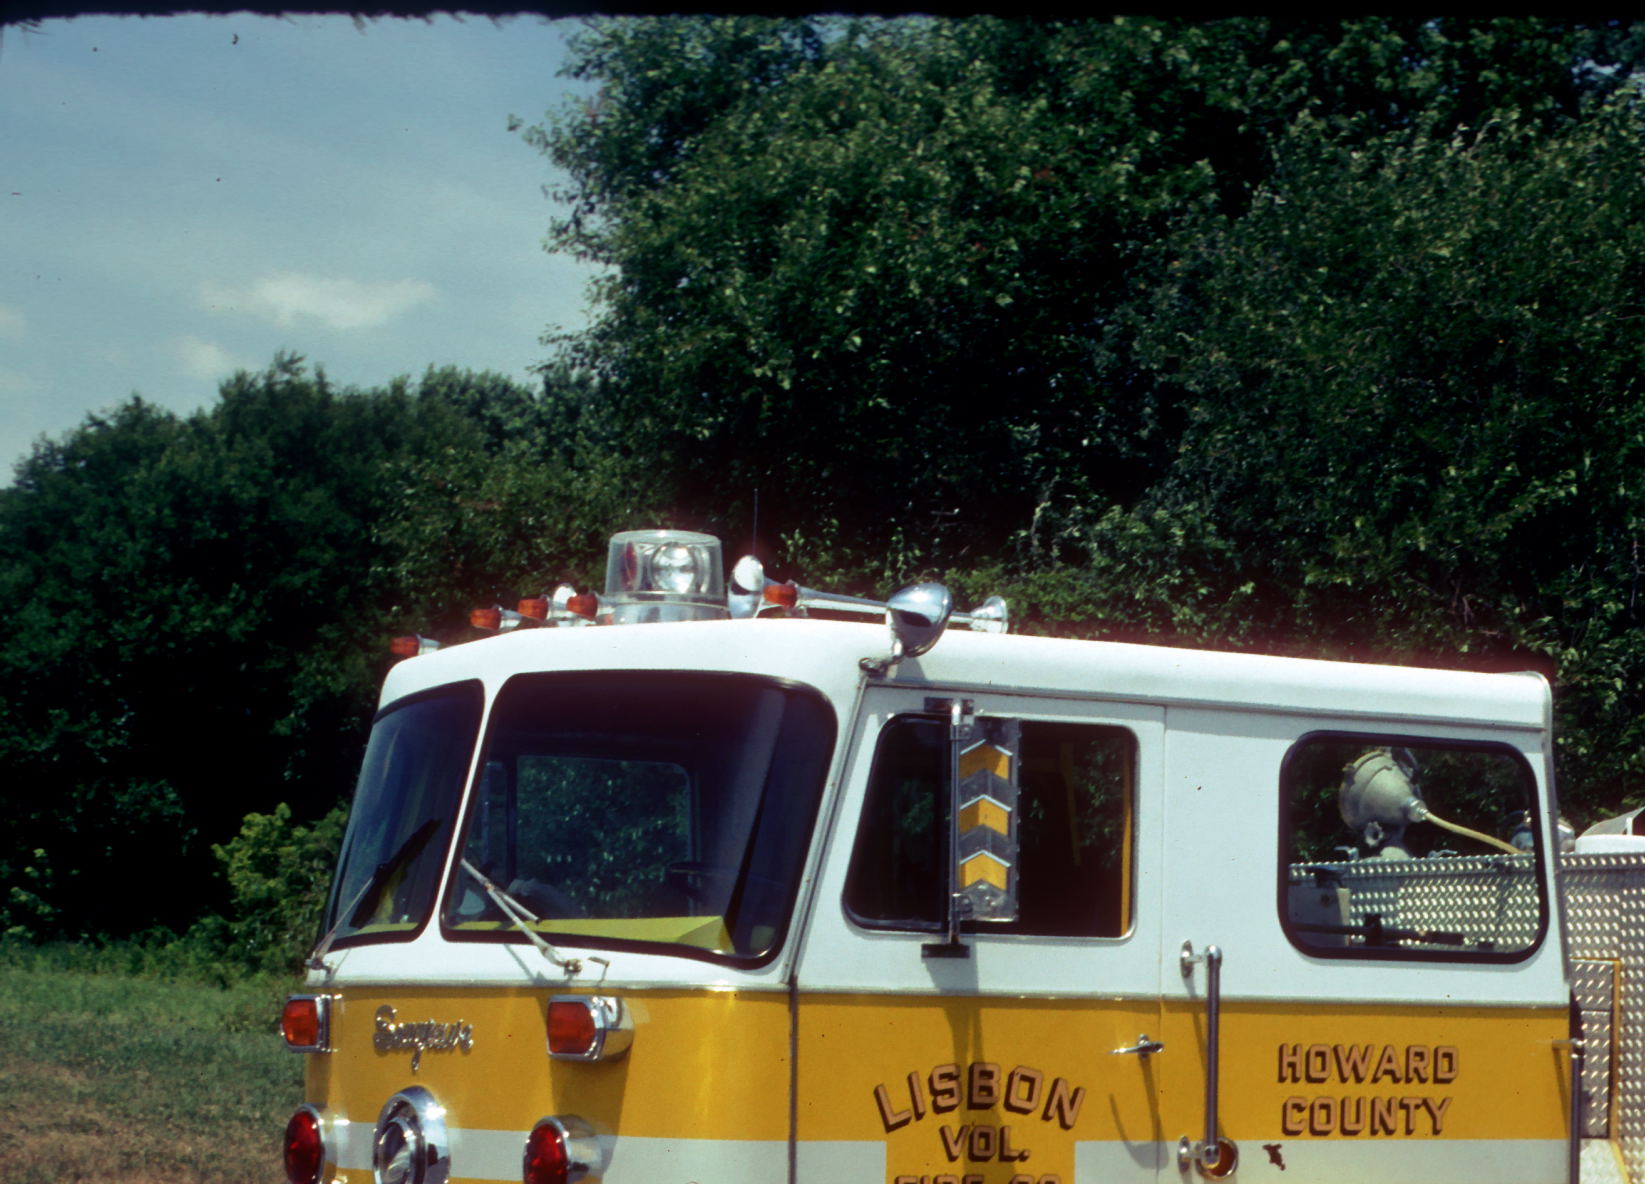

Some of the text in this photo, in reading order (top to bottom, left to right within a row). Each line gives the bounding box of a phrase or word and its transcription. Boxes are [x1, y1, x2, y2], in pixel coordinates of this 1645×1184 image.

[1278, 1042, 1460, 1084] HOWARD
[873, 1062, 1086, 1134] LISBON
[1282, 1095, 1453, 1137] COUNTY
[938, 1125, 1031, 1162] VOL.
